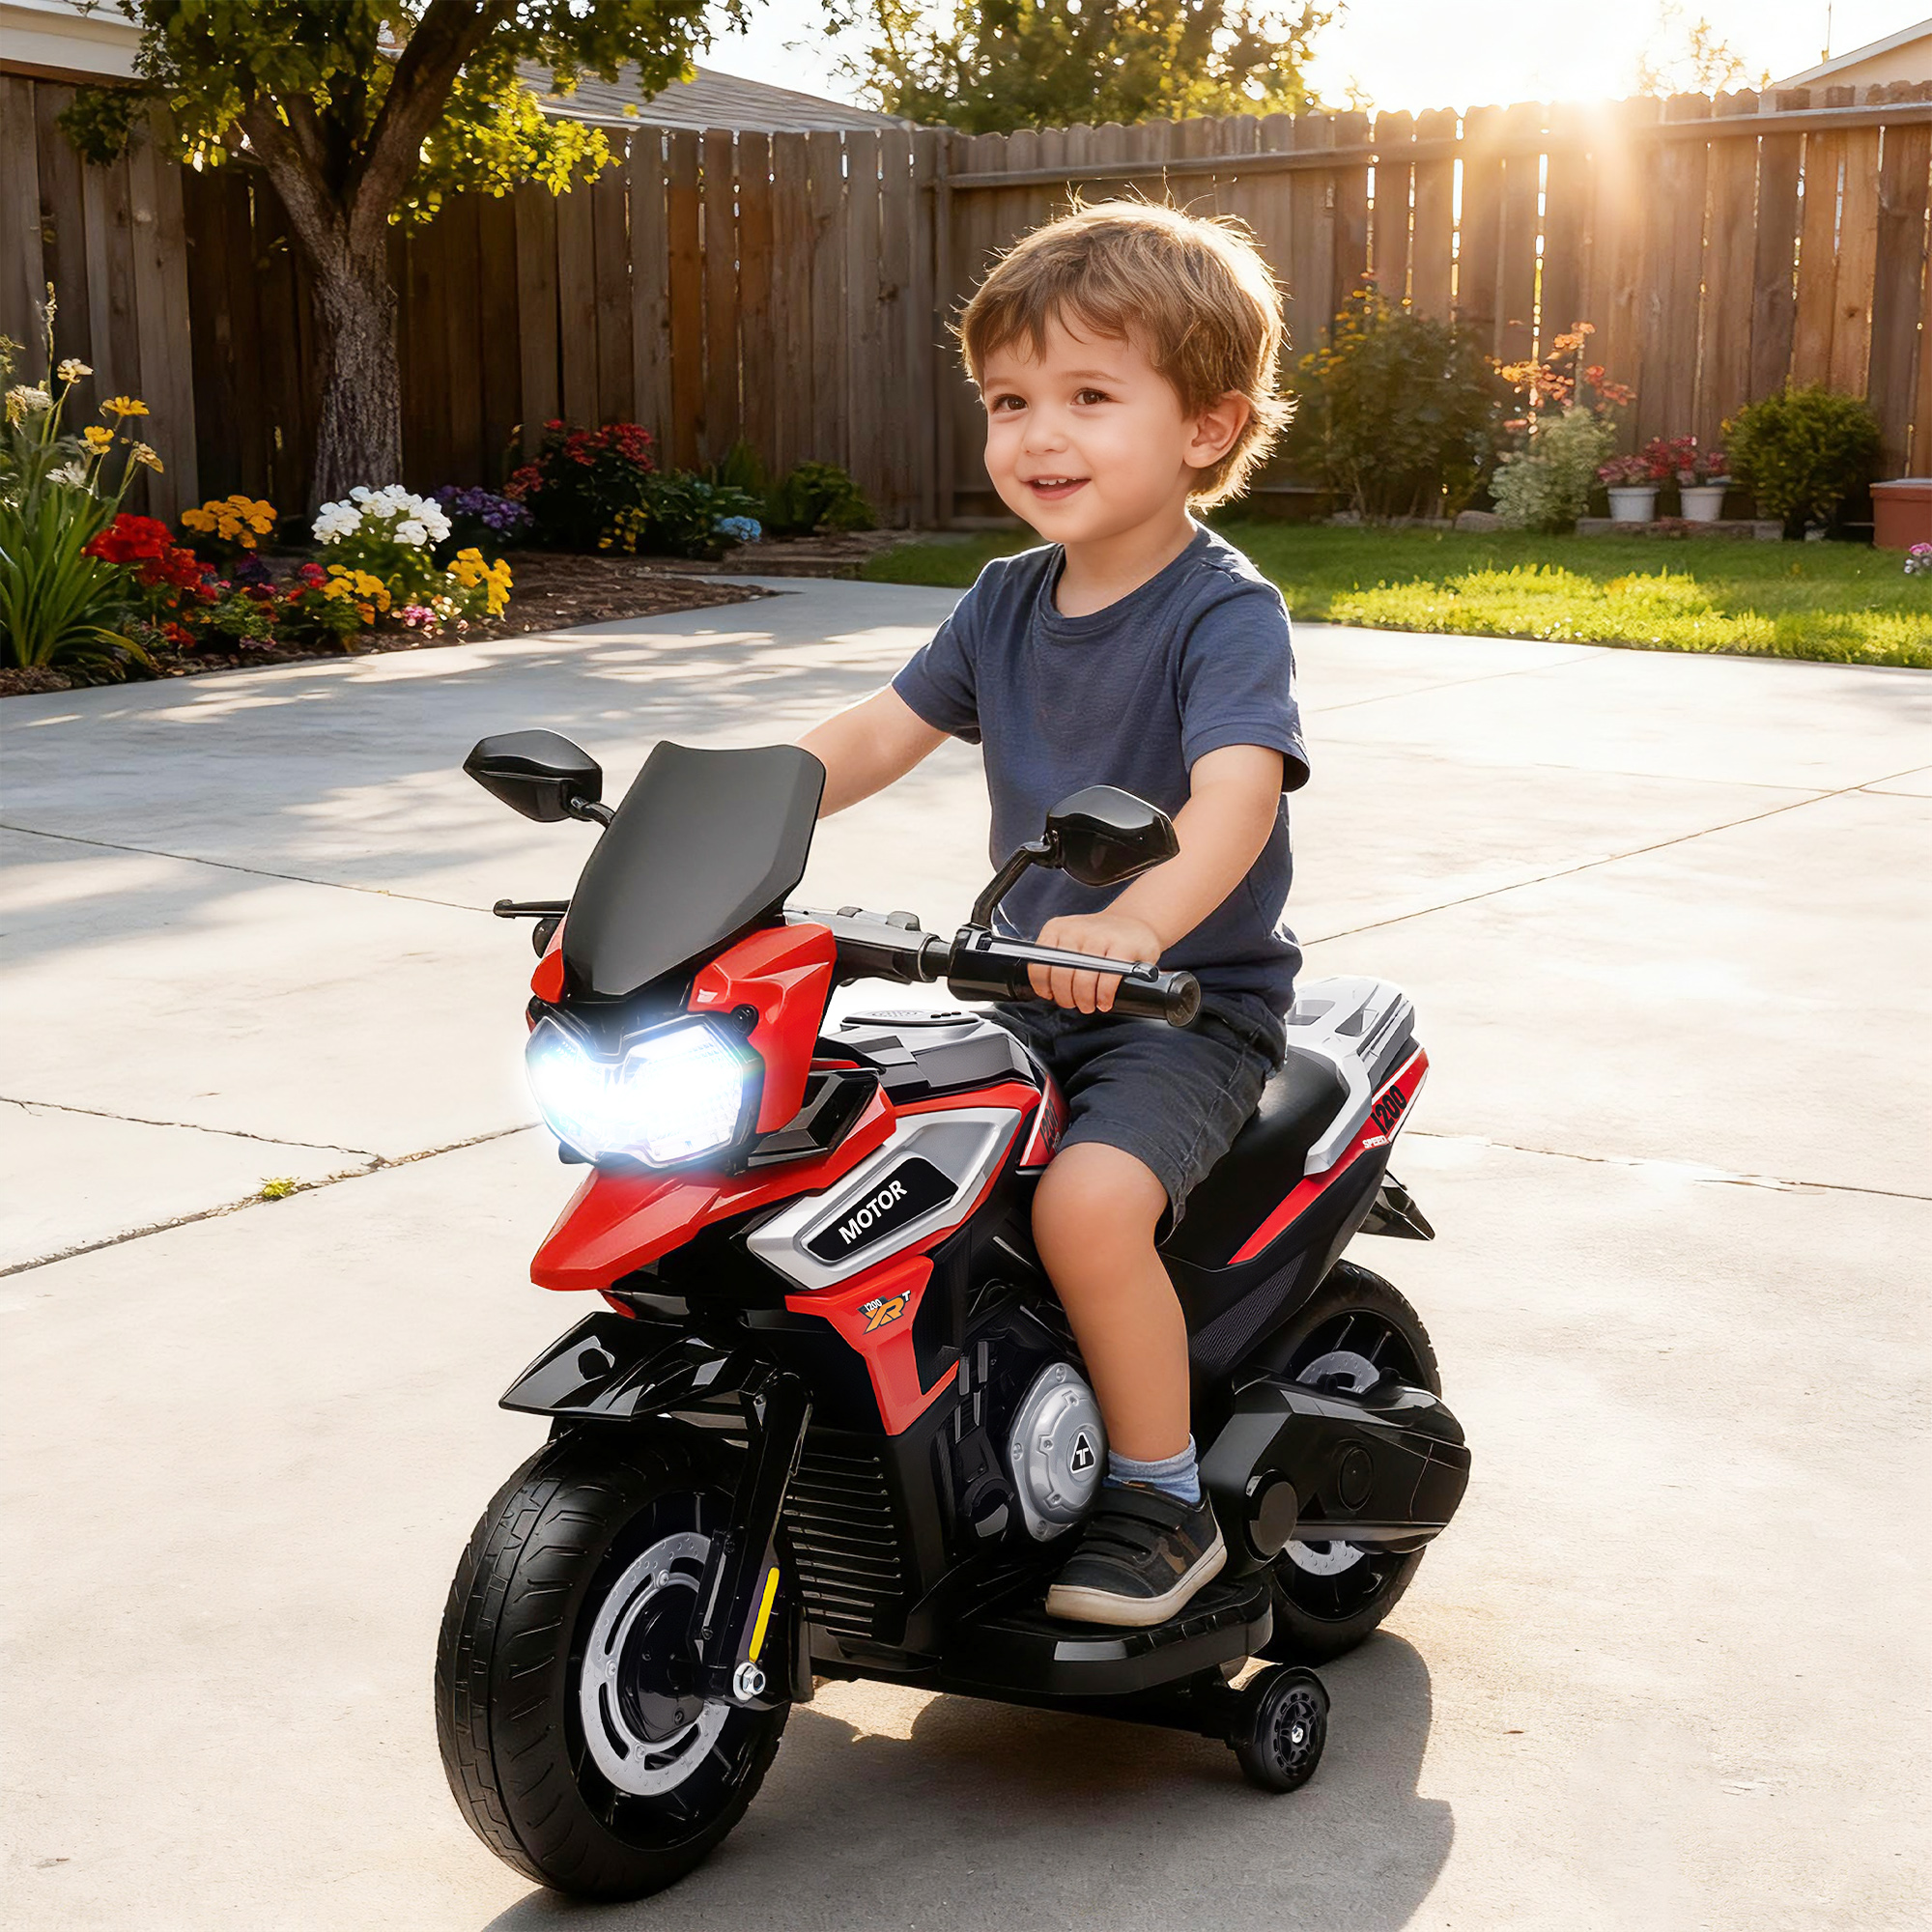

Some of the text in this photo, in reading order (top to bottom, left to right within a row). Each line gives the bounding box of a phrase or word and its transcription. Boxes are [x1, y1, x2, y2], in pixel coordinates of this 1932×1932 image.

[1370, 1084, 1407, 1136] 1200
[1362, 1135, 1388, 1149] SPEED
[838, 1179, 908, 1245] MOTOR
[865, 1298, 883, 1312] 1200
